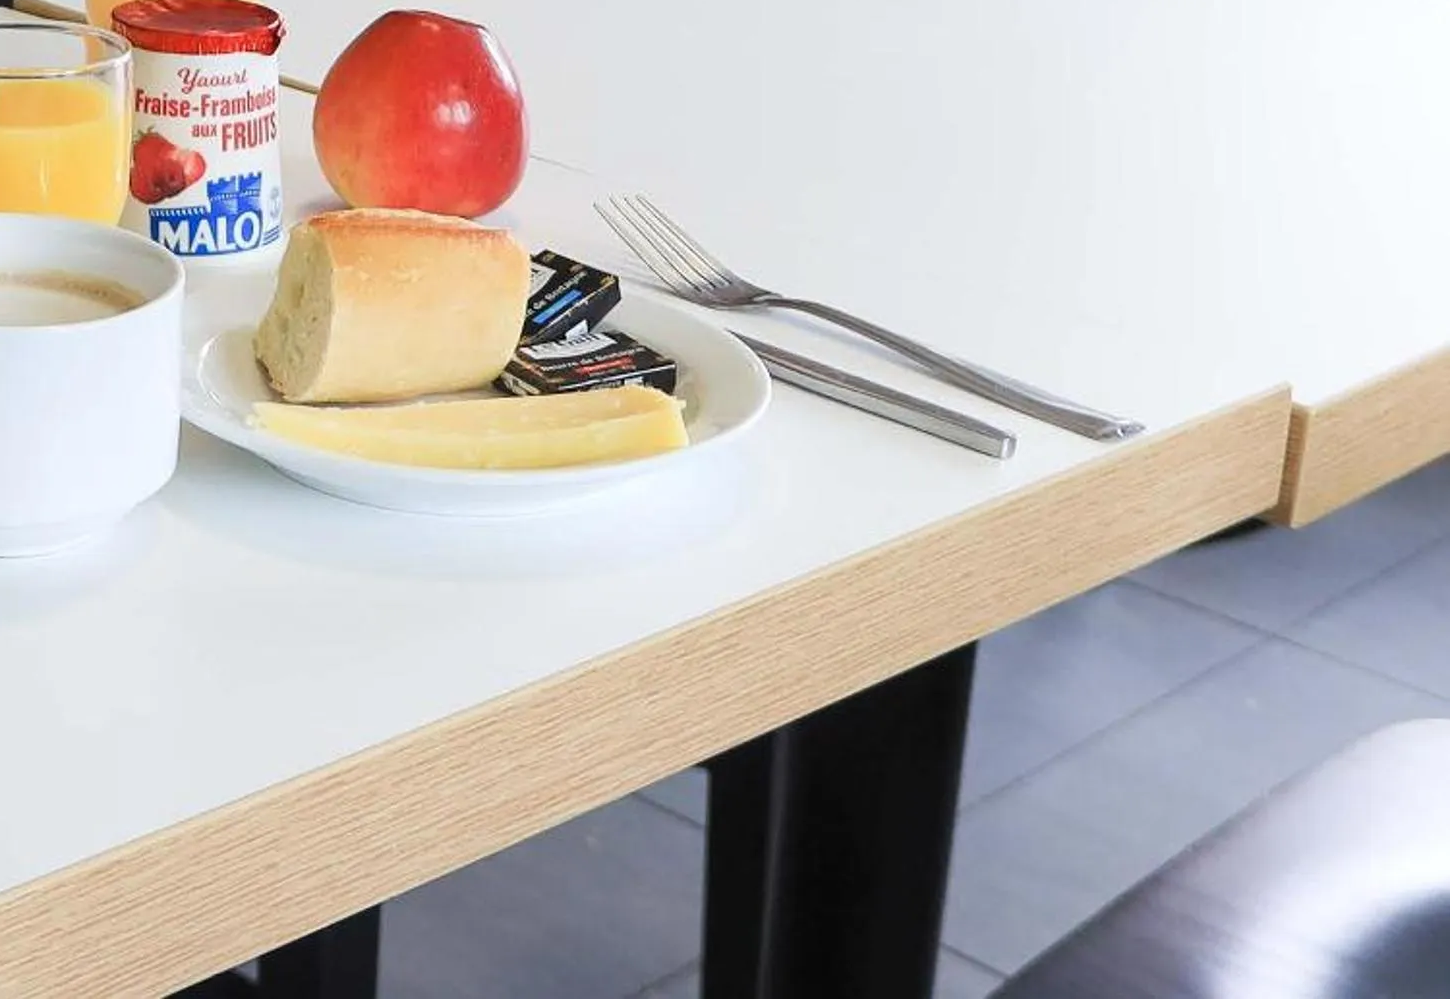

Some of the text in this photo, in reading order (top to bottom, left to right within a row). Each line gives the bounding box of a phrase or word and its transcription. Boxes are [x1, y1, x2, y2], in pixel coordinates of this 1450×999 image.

[177, 67, 247, 93] Yaourt
[191, 111, 276, 151] aux FRUITS
[158, 211, 261, 254] MALO
